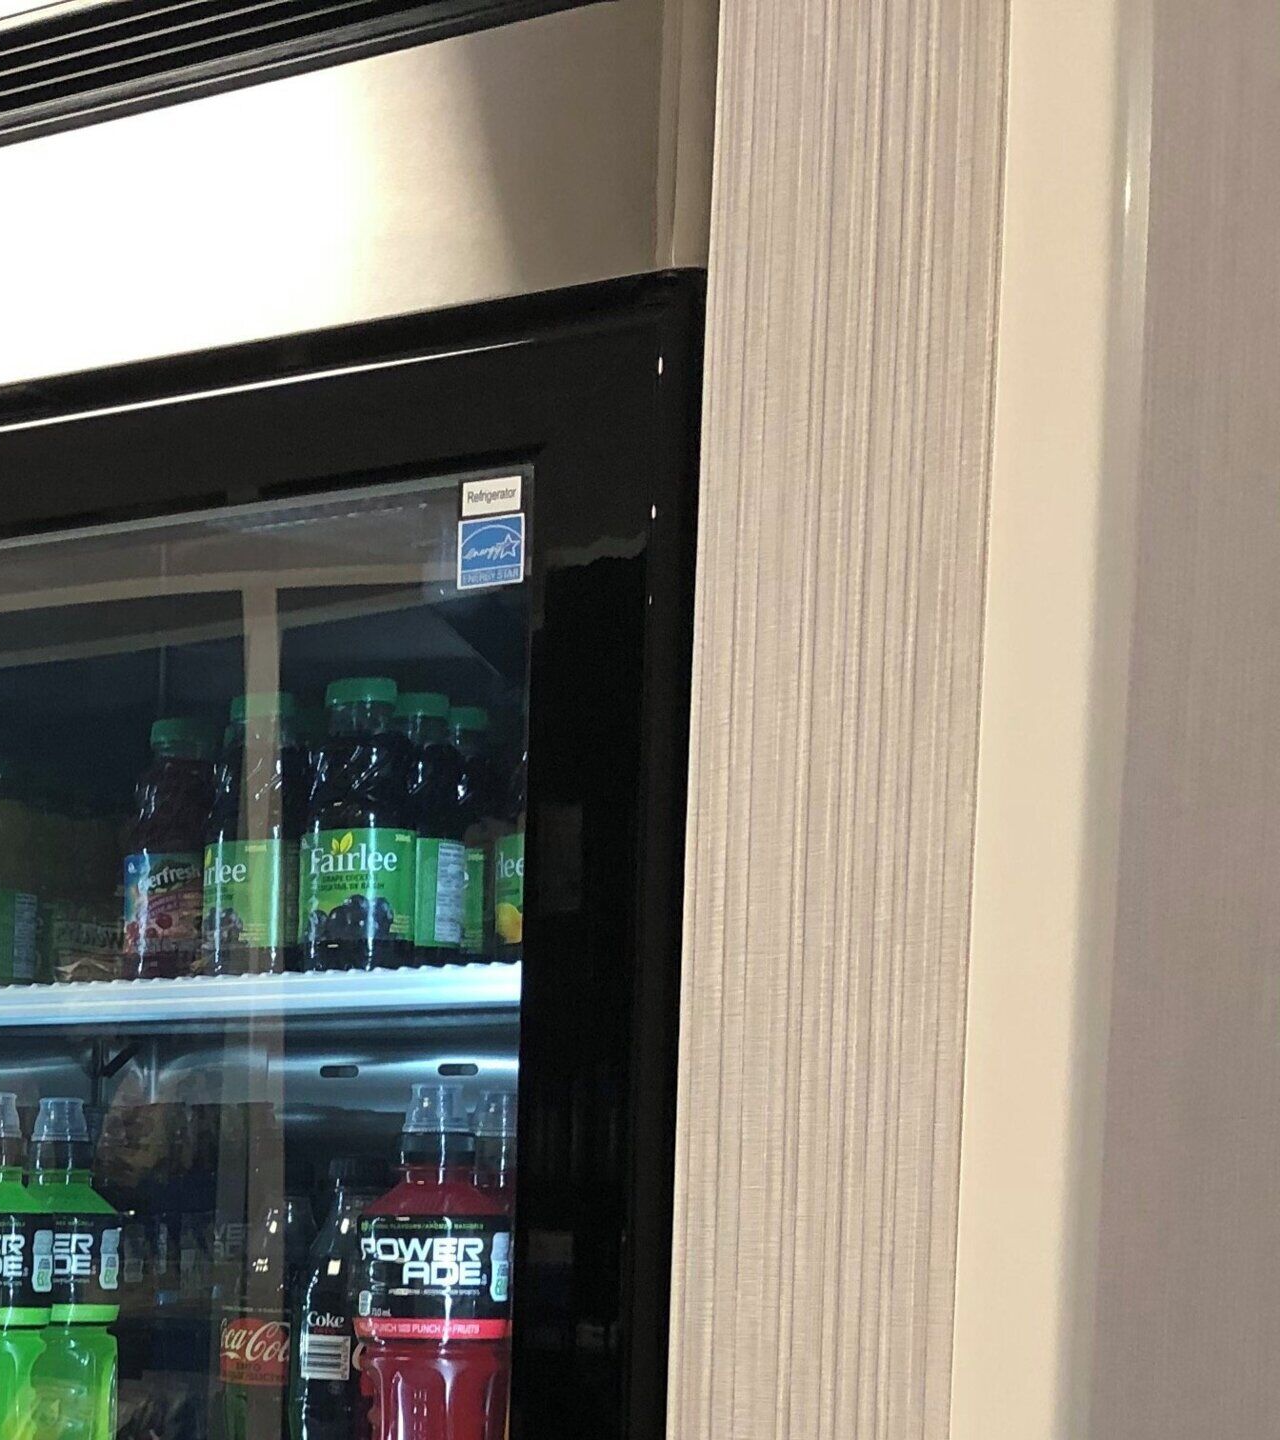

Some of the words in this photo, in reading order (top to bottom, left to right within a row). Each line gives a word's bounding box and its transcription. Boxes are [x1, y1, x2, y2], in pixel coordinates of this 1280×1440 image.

[467, 487, 517, 504] Refrigerator
[310, 843, 398, 874] Fairlee
[361, 1237, 484, 1261] POWER
[402, 1261, 482, 1286] ADE
[307, 1311, 345, 1329] Coke
[412, 1325, 440, 1334] PUNCH
